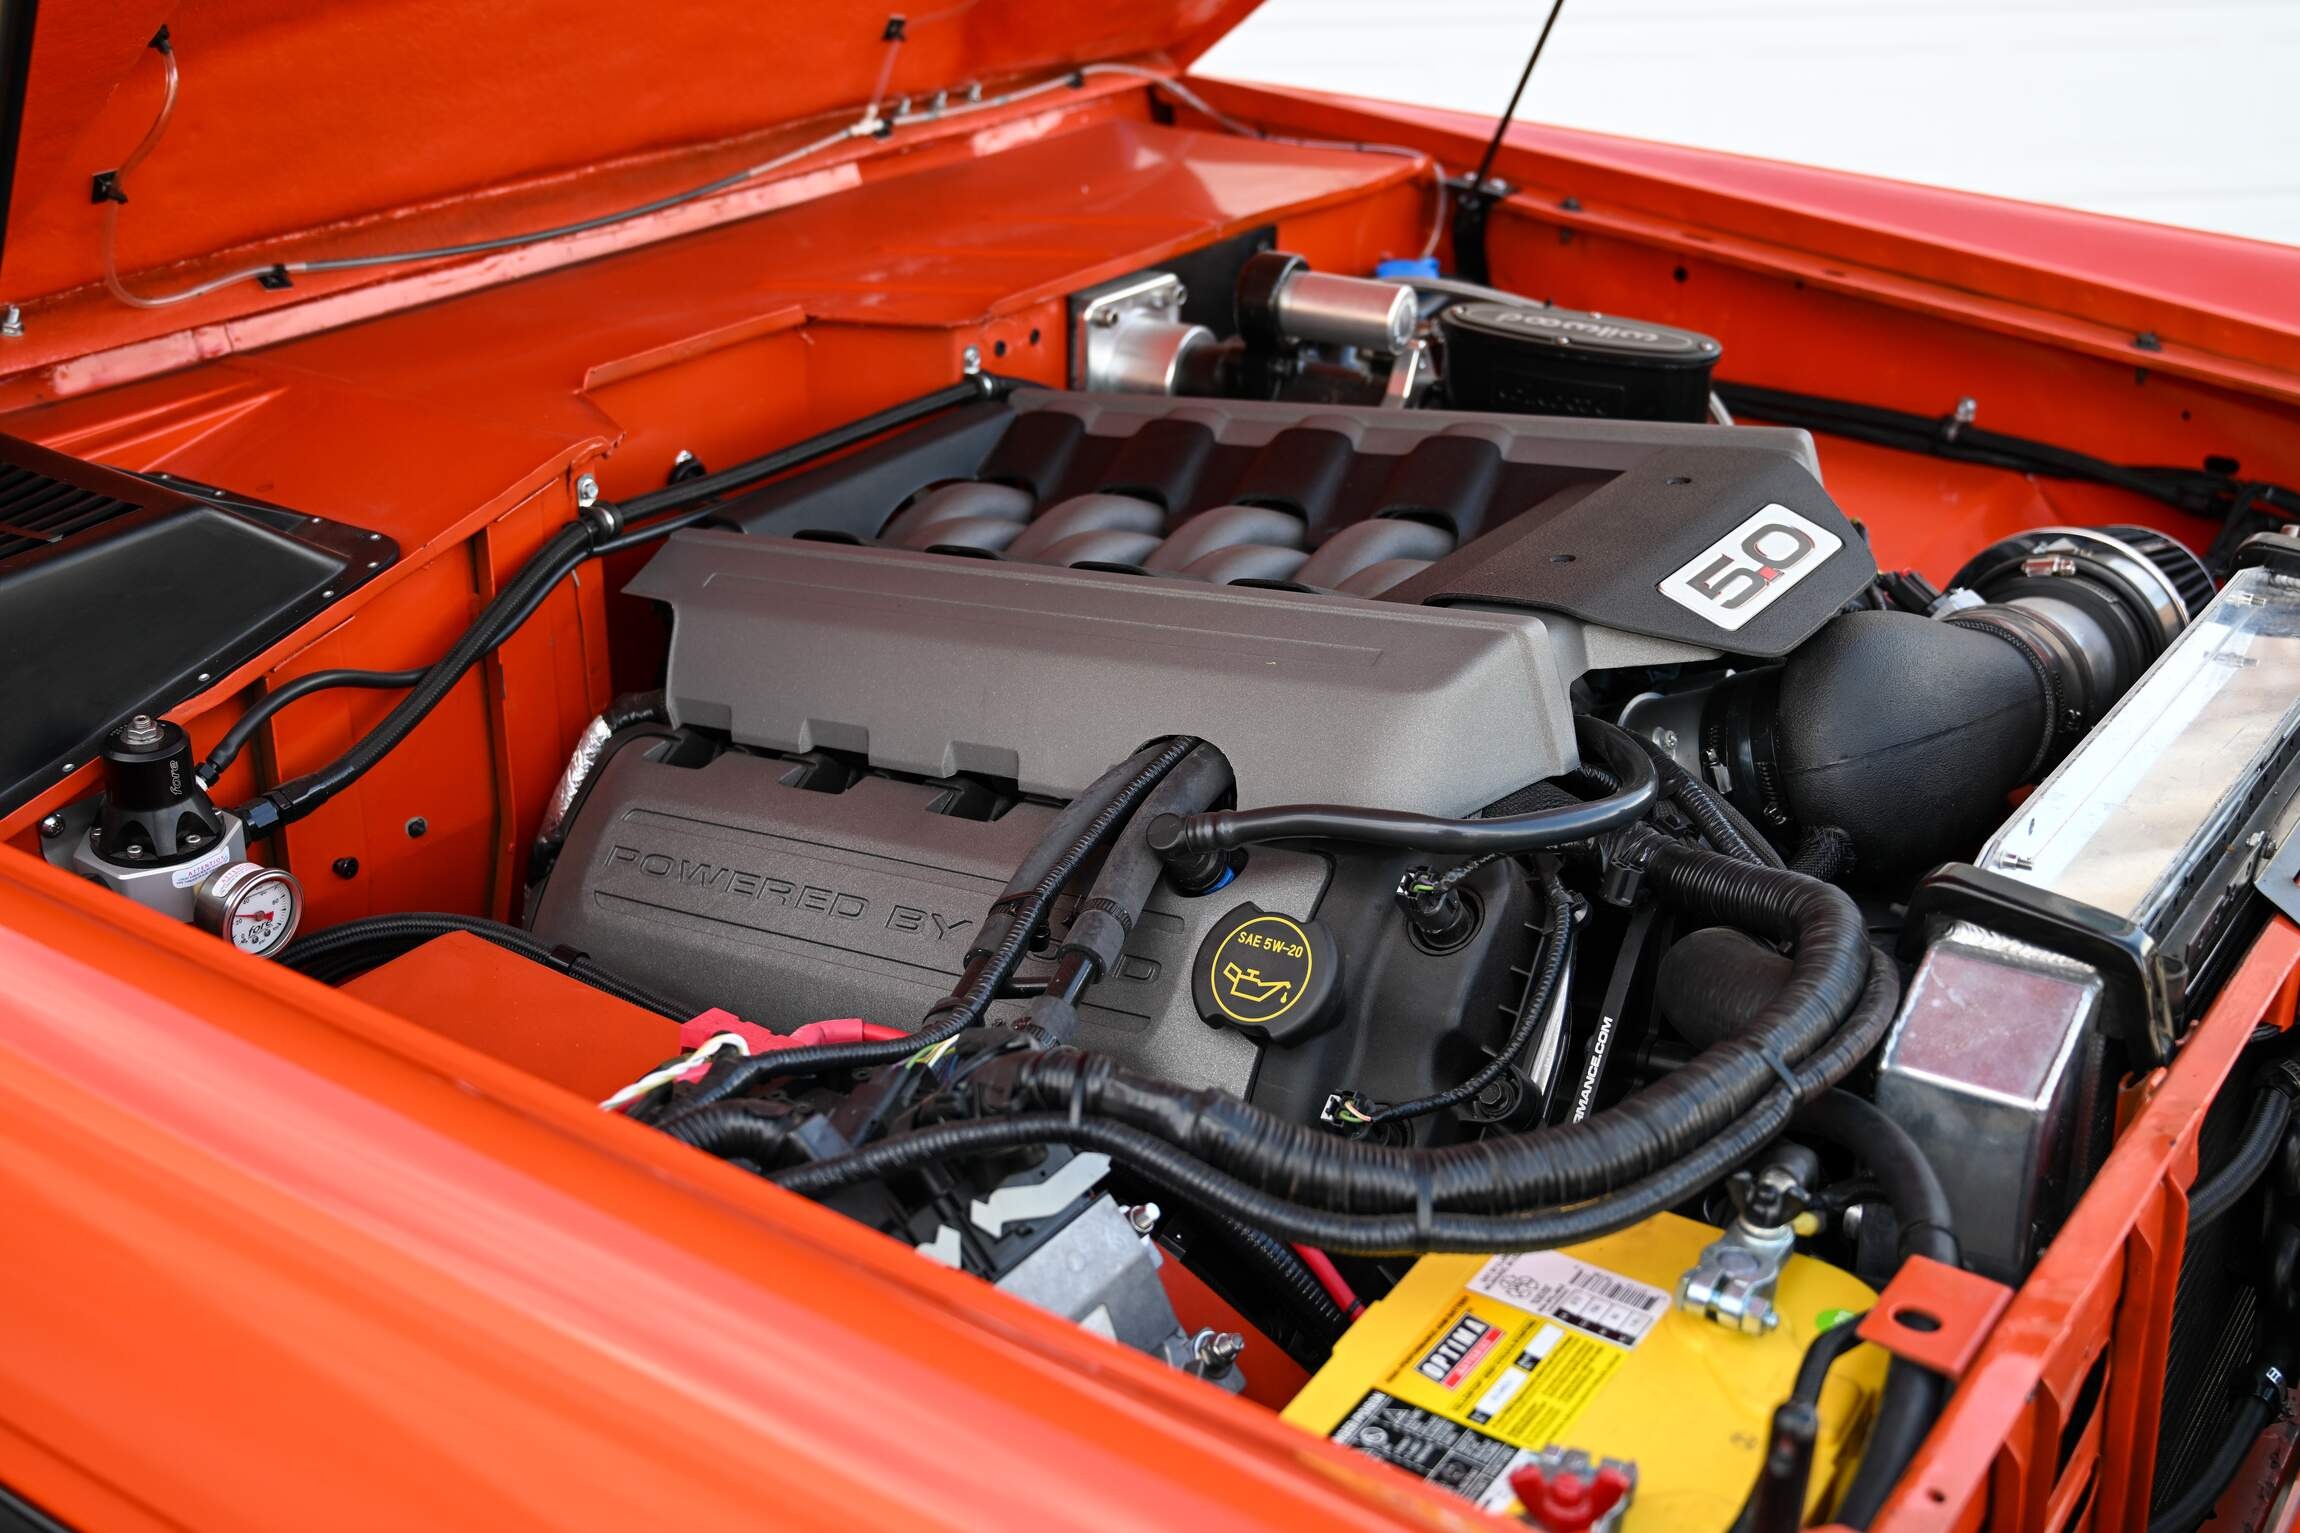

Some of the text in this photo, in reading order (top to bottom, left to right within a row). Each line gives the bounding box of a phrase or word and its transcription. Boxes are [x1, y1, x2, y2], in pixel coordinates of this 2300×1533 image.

[1496, 312, 1659, 342] wilwood
[1686, 523, 1815, 609] 5.0
[170, 760, 182, 795] fore
[604, 845, 974, 940] POWERED BY
[1238, 931, 1304, 958] SAE 5W-20
[1421, 1318, 1488, 1380] OPTIMA
